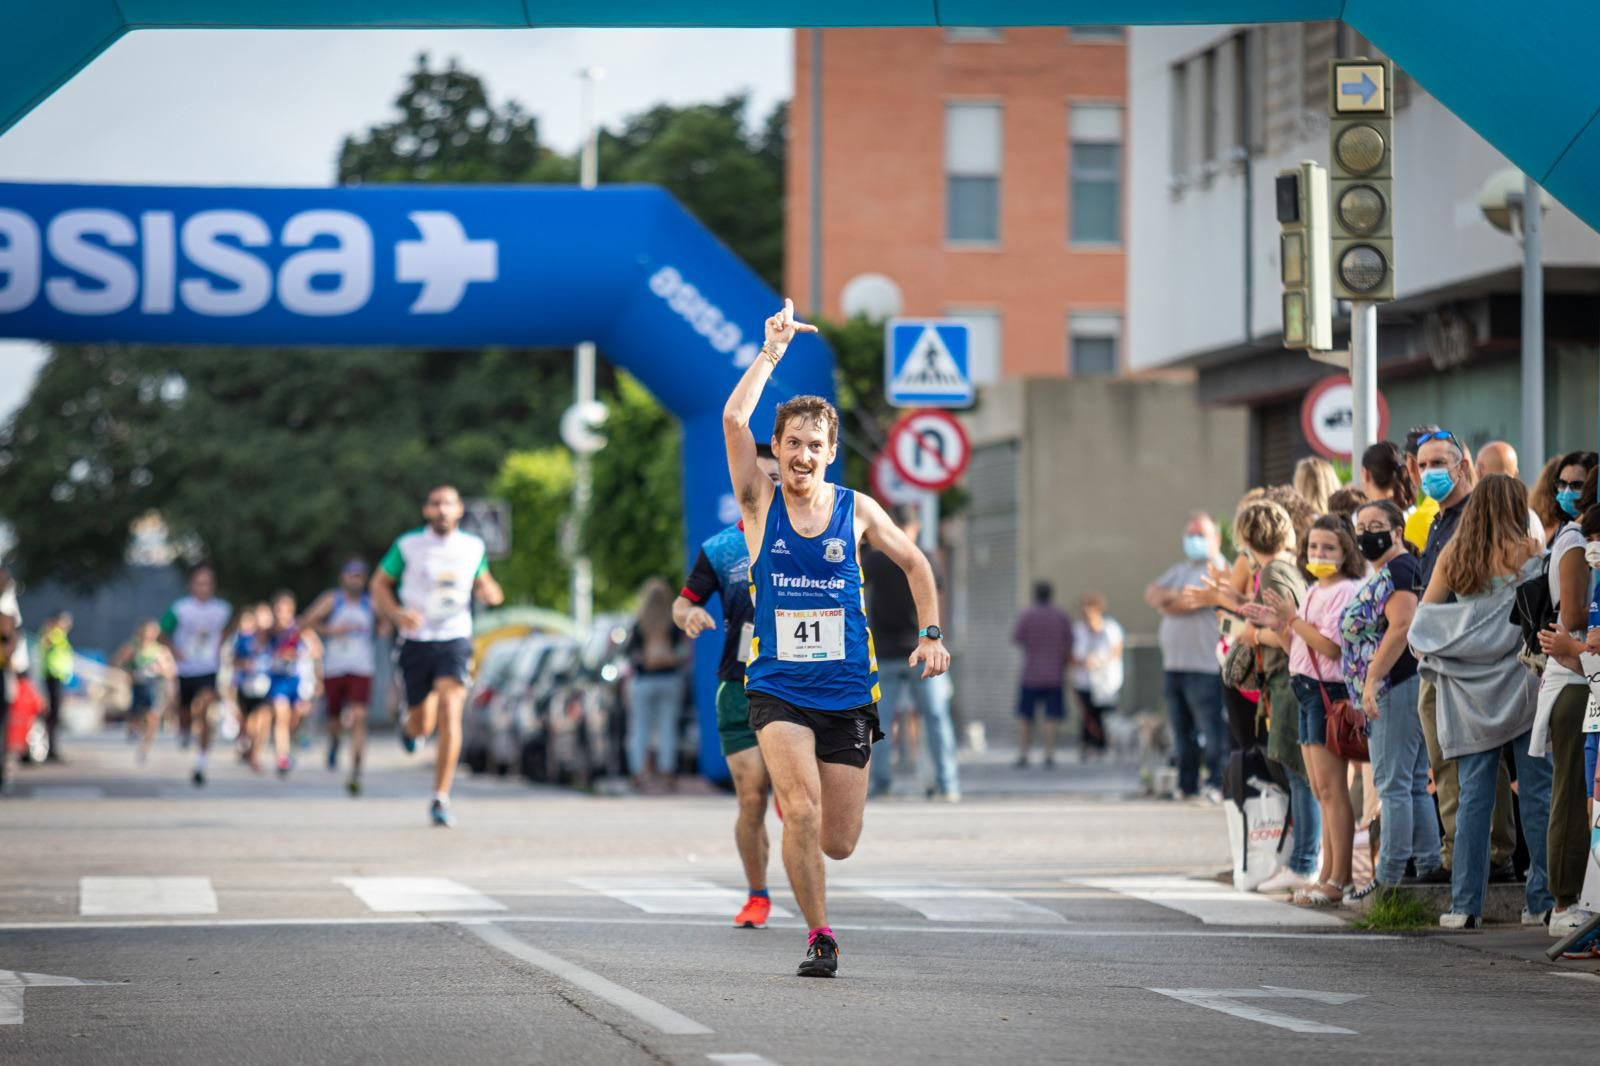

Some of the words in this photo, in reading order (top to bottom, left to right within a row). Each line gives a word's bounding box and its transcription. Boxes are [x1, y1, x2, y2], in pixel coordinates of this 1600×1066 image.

[770, 572, 846, 590] Tirabuzón
[819, 609, 844, 617] VERDE
[793, 620, 821, 643] 41
